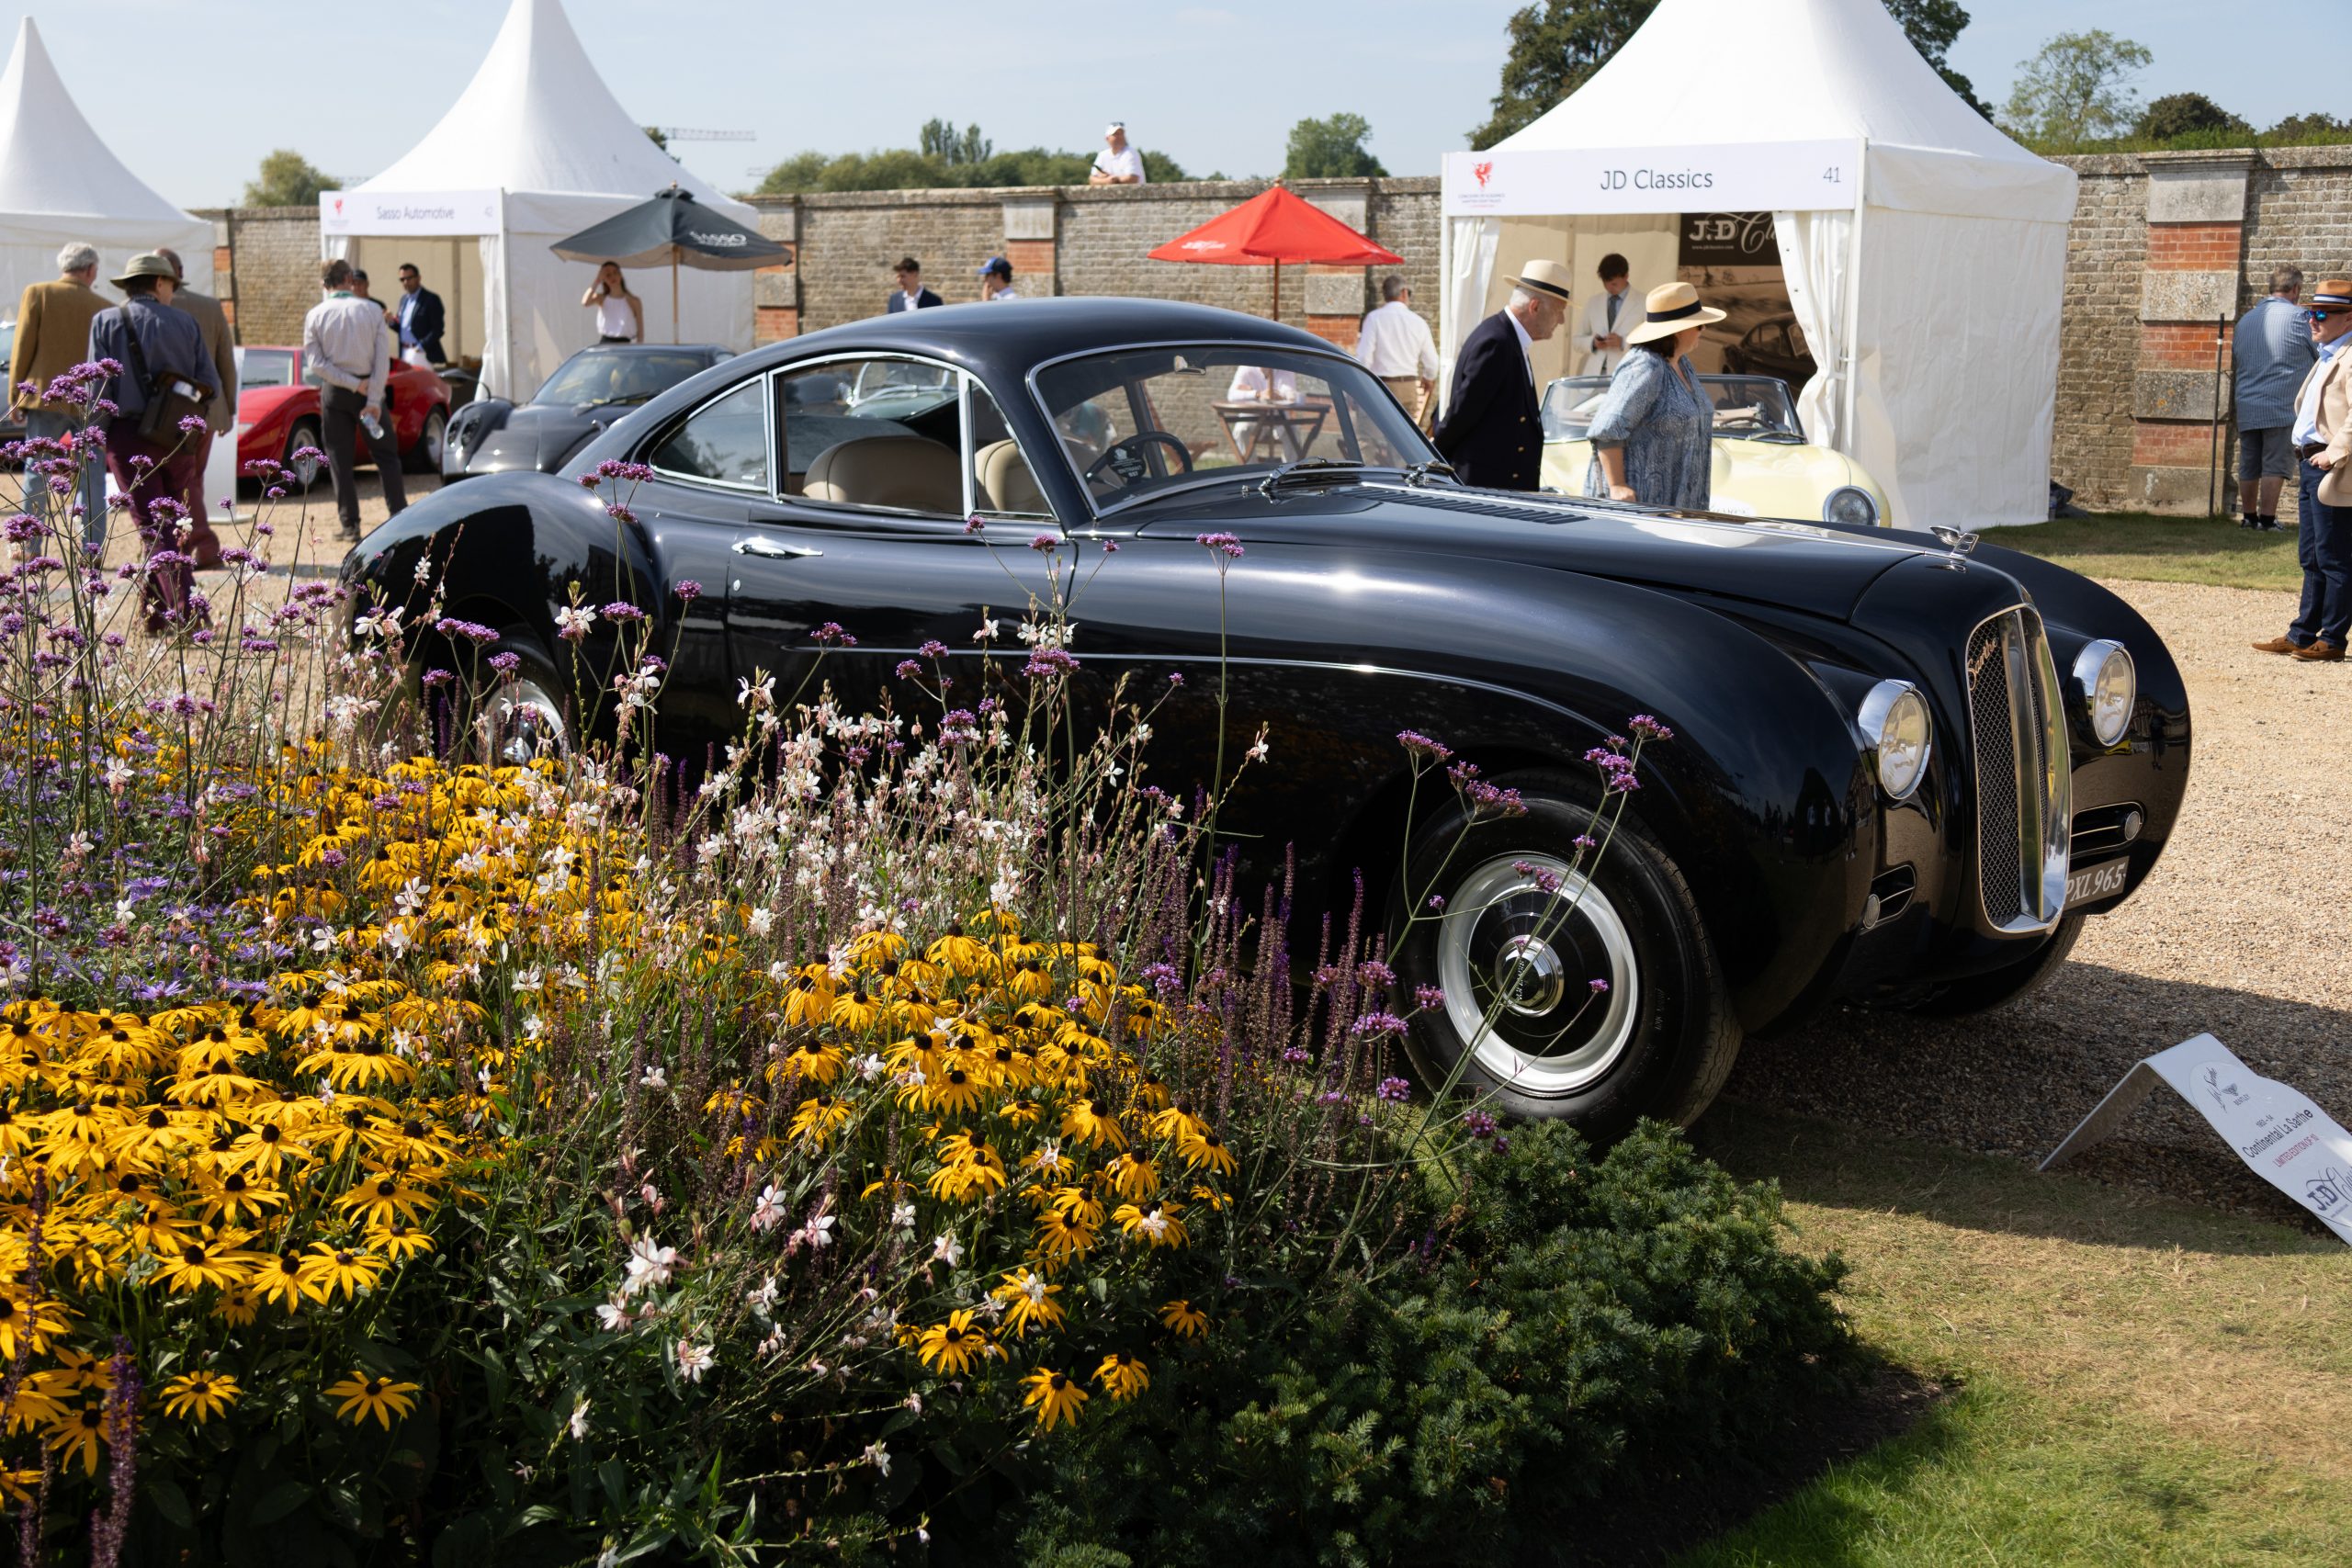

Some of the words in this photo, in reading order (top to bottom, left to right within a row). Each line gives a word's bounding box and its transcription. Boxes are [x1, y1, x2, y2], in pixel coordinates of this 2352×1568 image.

[1600, 170, 1627, 190] JD
[1634, 168, 1713, 189] Classics
[1823, 166, 1841, 183] 41
[377, 207, 401, 220] Sasso
[404, 206, 456, 220] Automotive
[2092, 863, 2126, 896] 965
[2280, 1122, 2293, 1134] La
[2286, 1109, 2313, 1129] Sarthe
[2242, 1125, 2284, 1158] Continental
